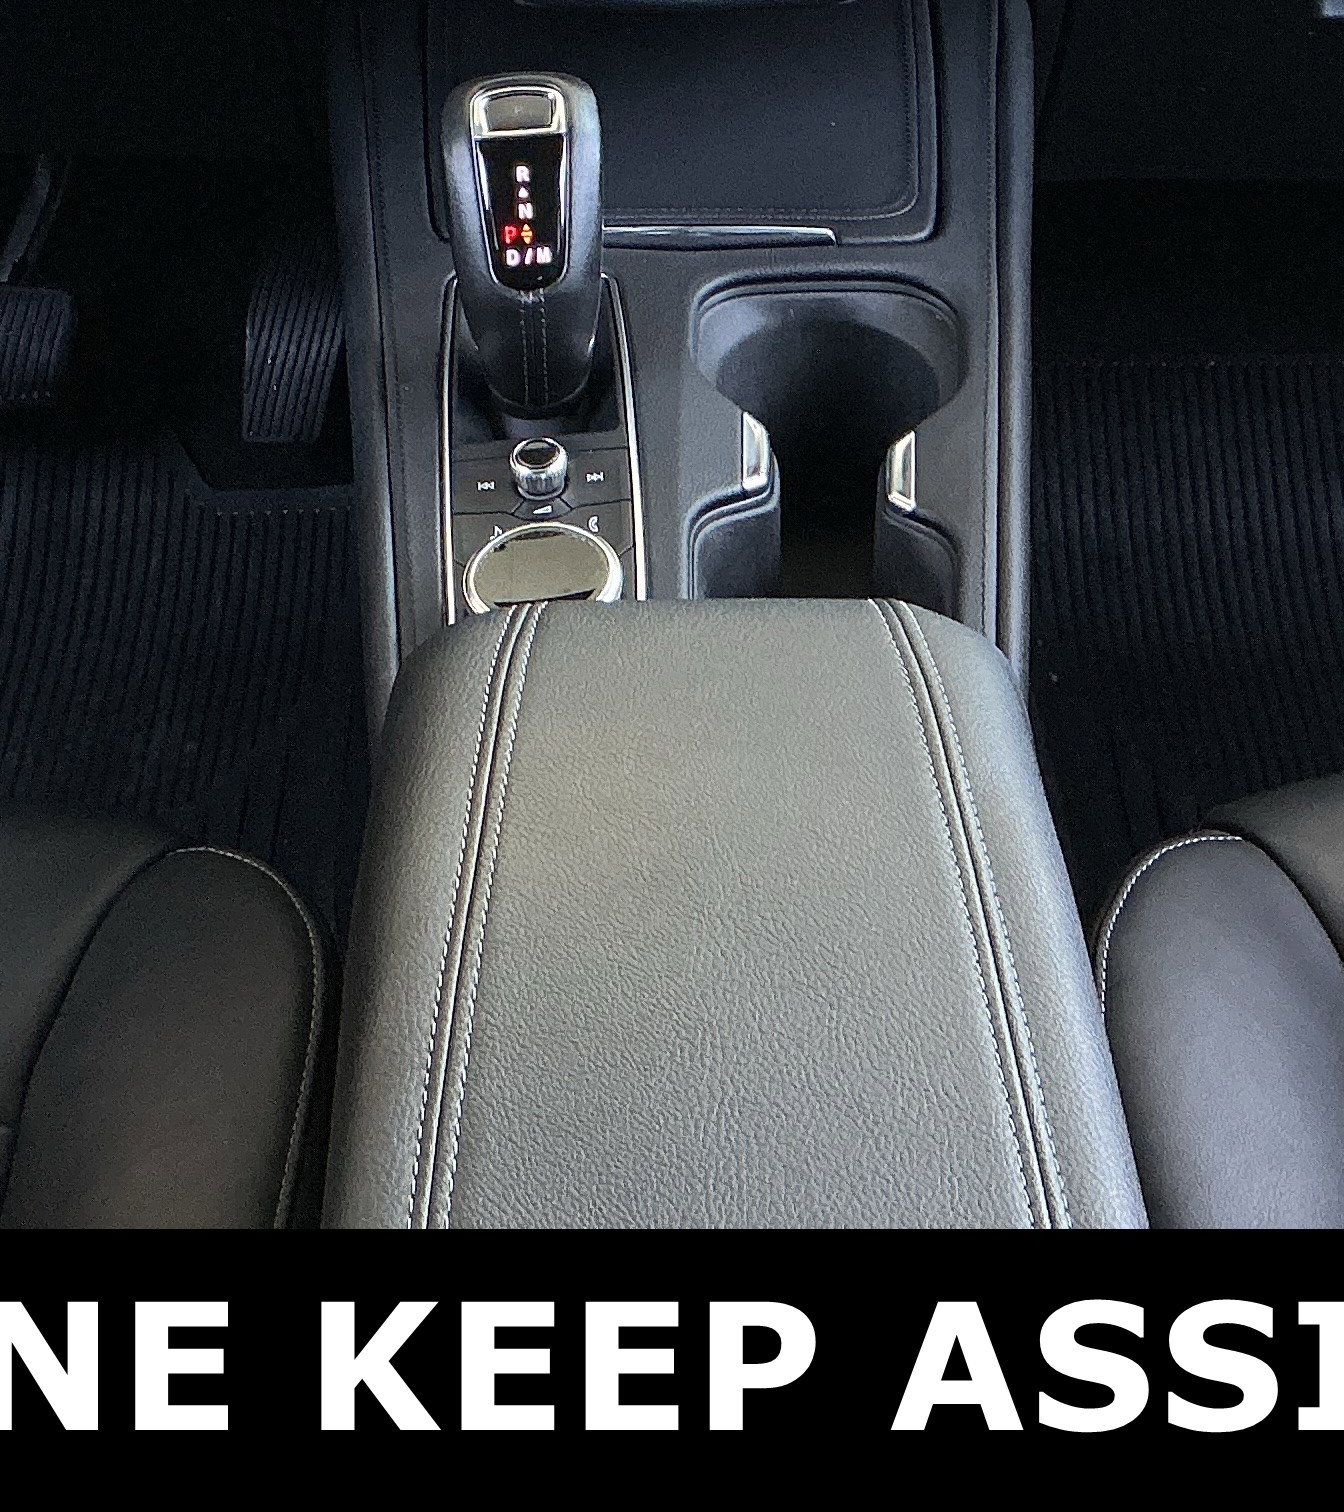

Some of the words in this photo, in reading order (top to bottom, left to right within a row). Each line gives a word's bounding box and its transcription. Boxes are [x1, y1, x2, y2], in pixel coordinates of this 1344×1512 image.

[515, 165, 530, 182] R
[518, 202, 533, 219] N
[504, 225, 517, 243] P
